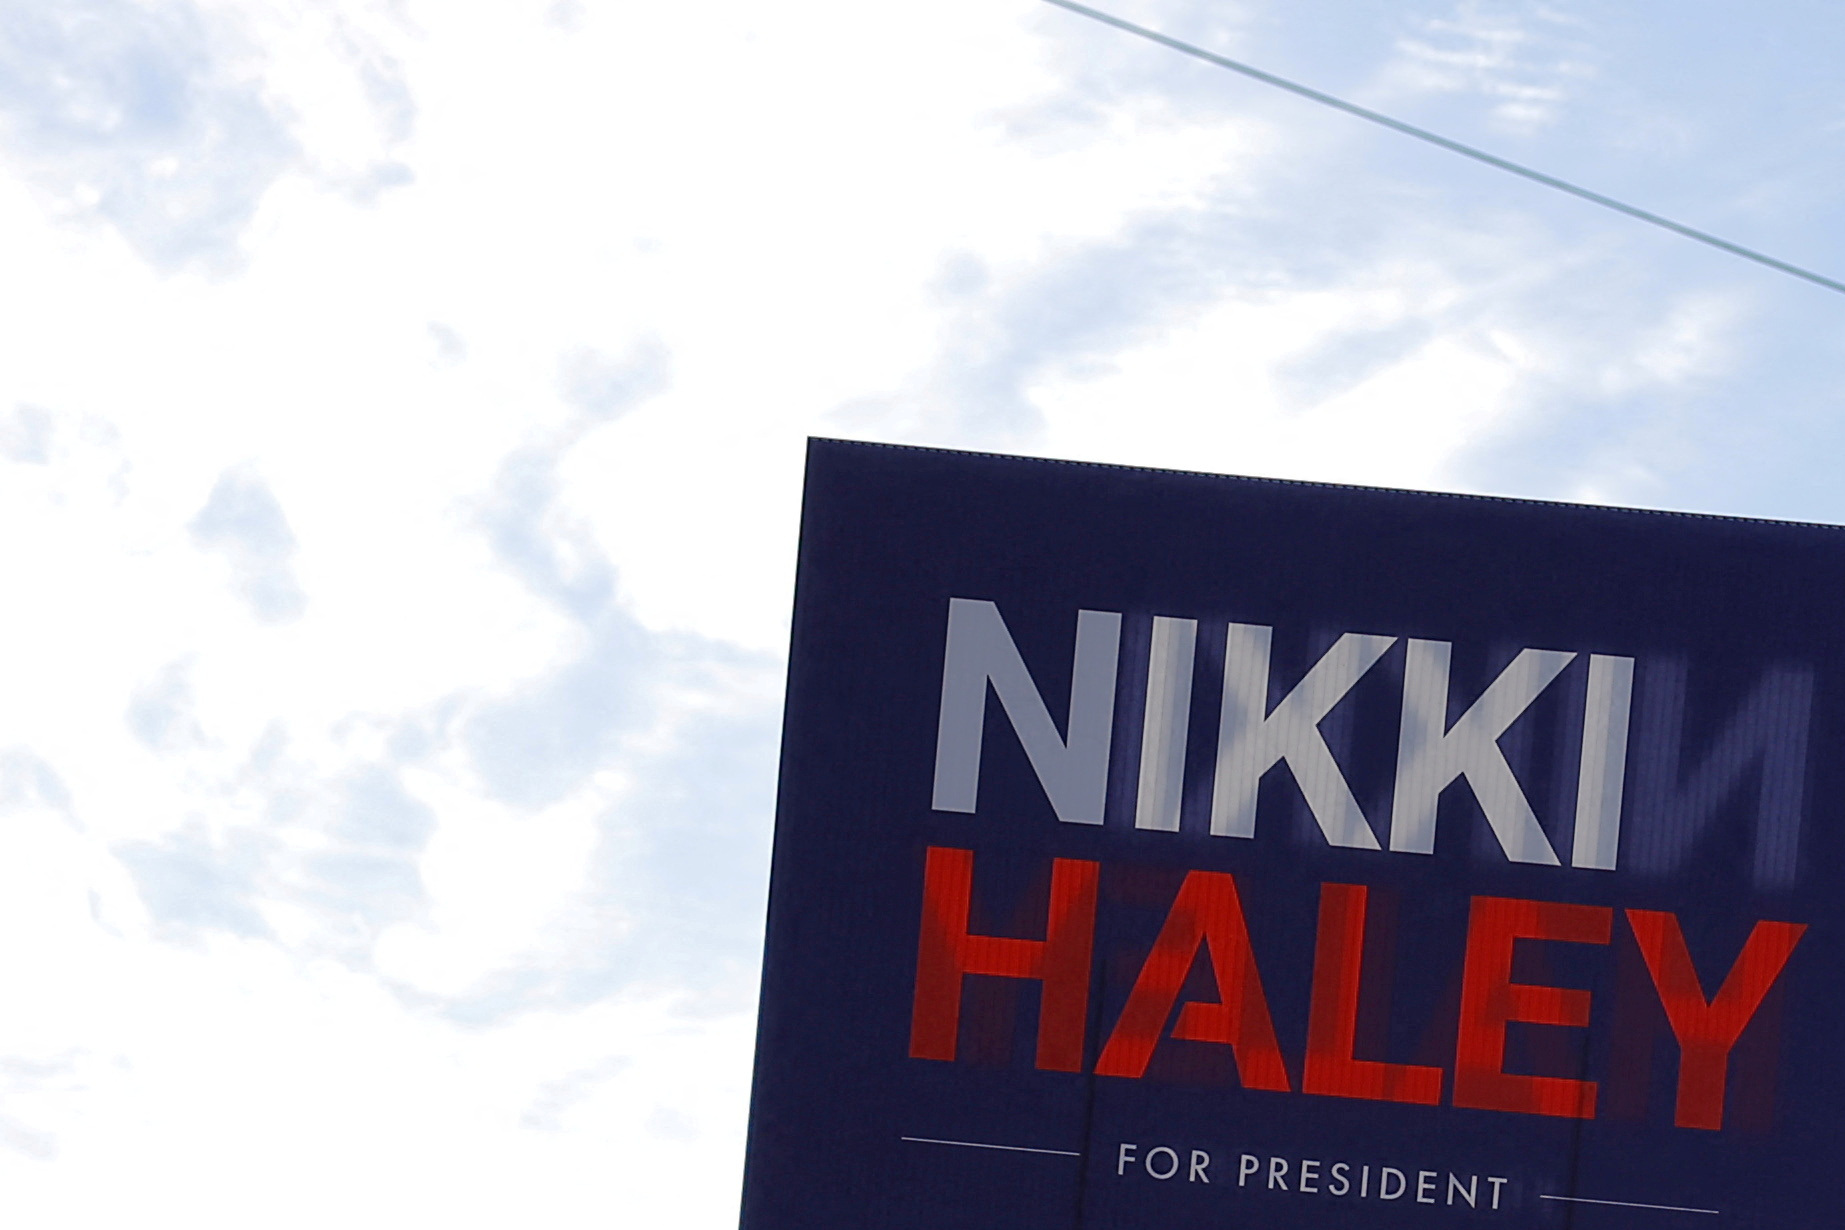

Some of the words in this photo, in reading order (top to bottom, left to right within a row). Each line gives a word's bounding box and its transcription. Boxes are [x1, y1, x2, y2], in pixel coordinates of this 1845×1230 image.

[931, 597, 1635, 871] NIKKI
[907, 844, 1809, 1131] HALEY
[1117, 1143, 1210, 1183] FOR
[1238, 1154, 1508, 1209] PRESIDENT
